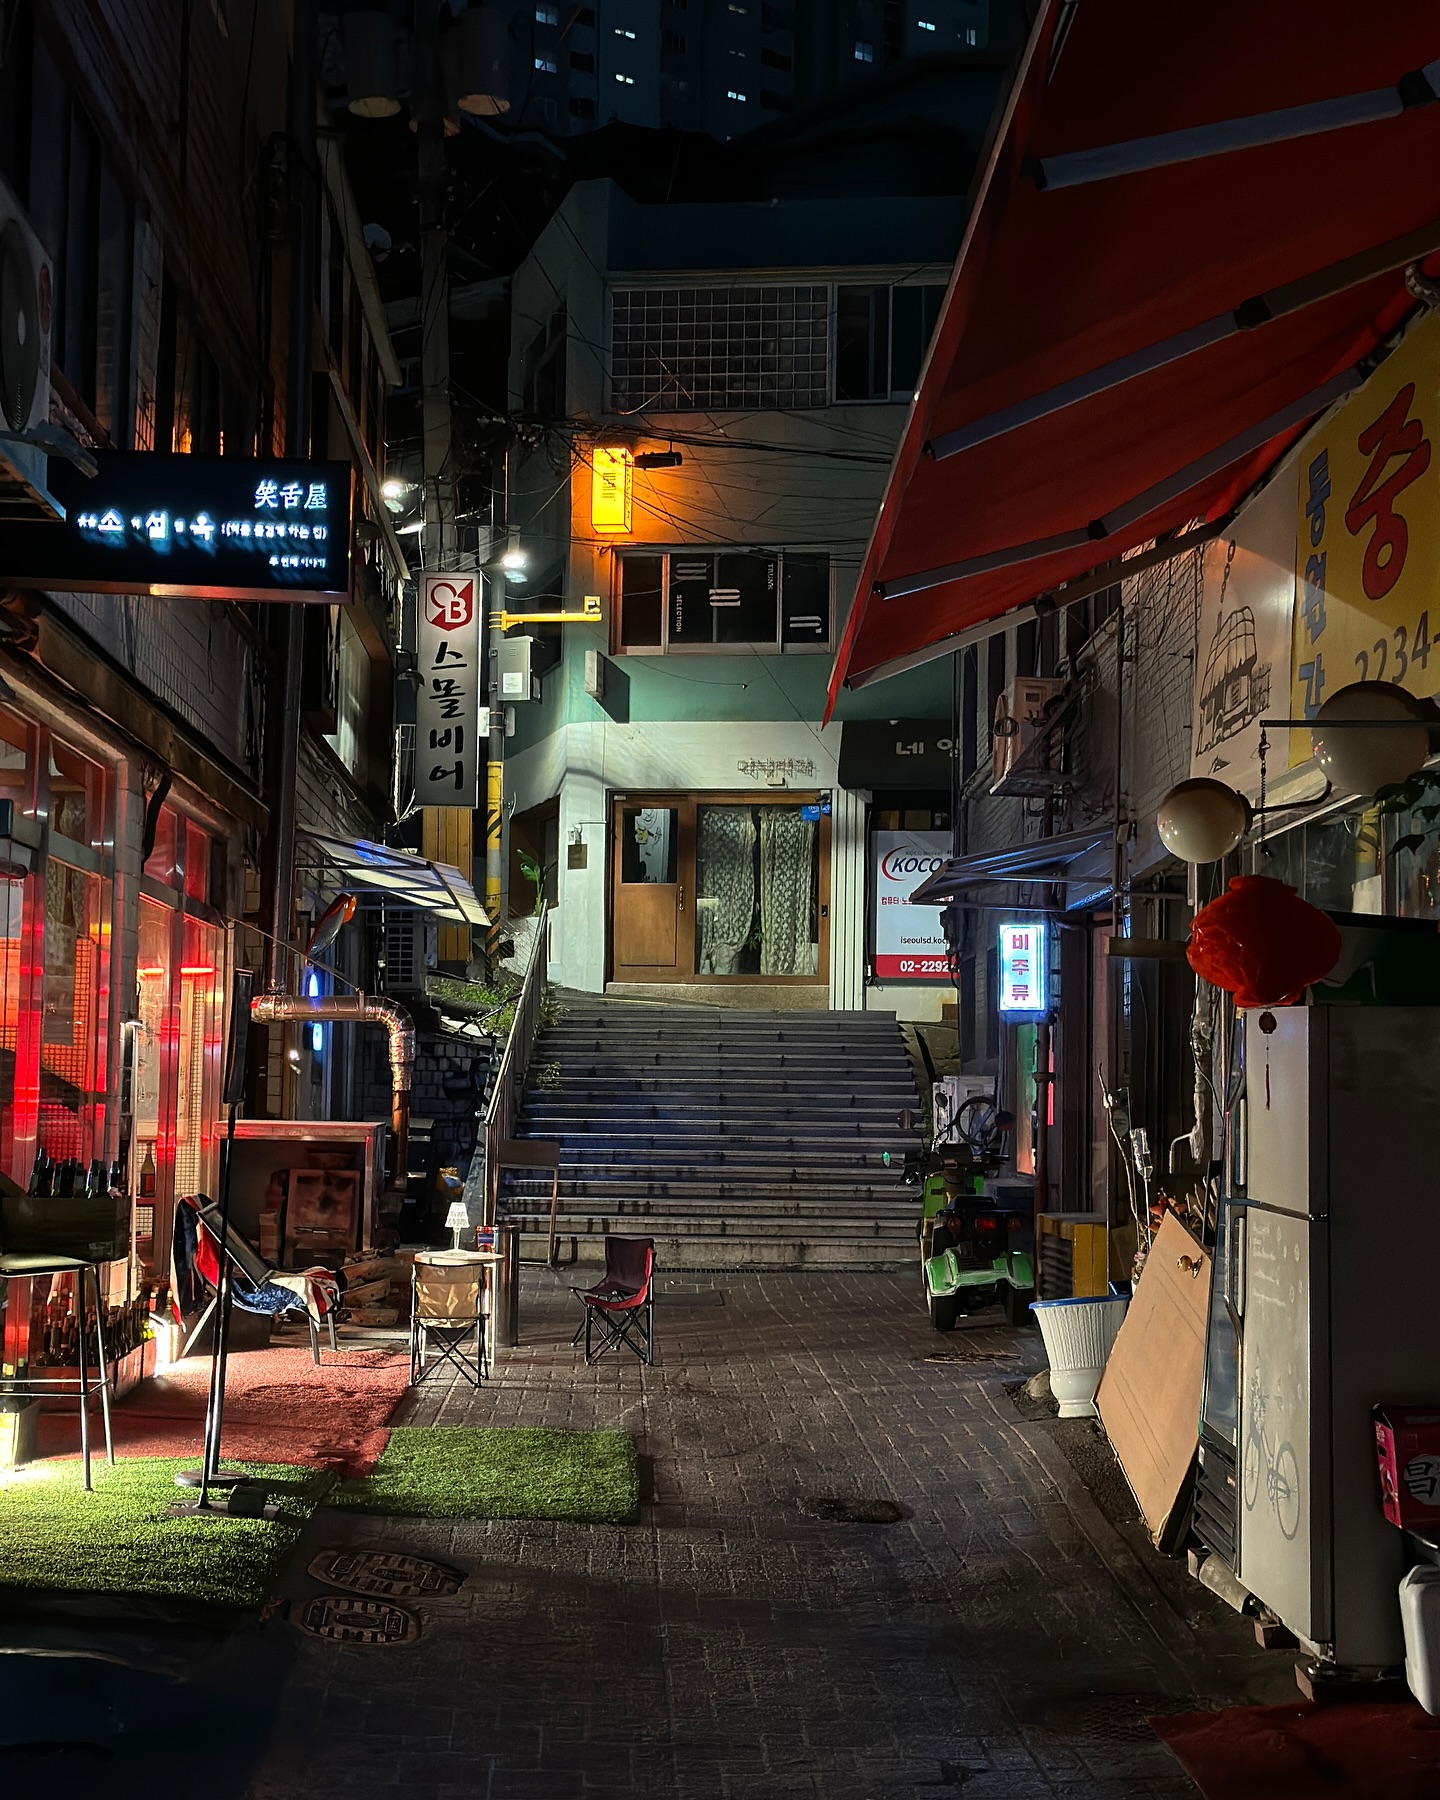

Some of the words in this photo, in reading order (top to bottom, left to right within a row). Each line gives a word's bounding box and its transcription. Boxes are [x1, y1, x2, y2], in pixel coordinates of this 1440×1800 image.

[254, 479, 327, 510] 笑舌屋
[429, 641, 468, 791] 스몰비어
[891, 857, 950, 873] KOCO
[1011, 933, 1030, 1001] 비주류
